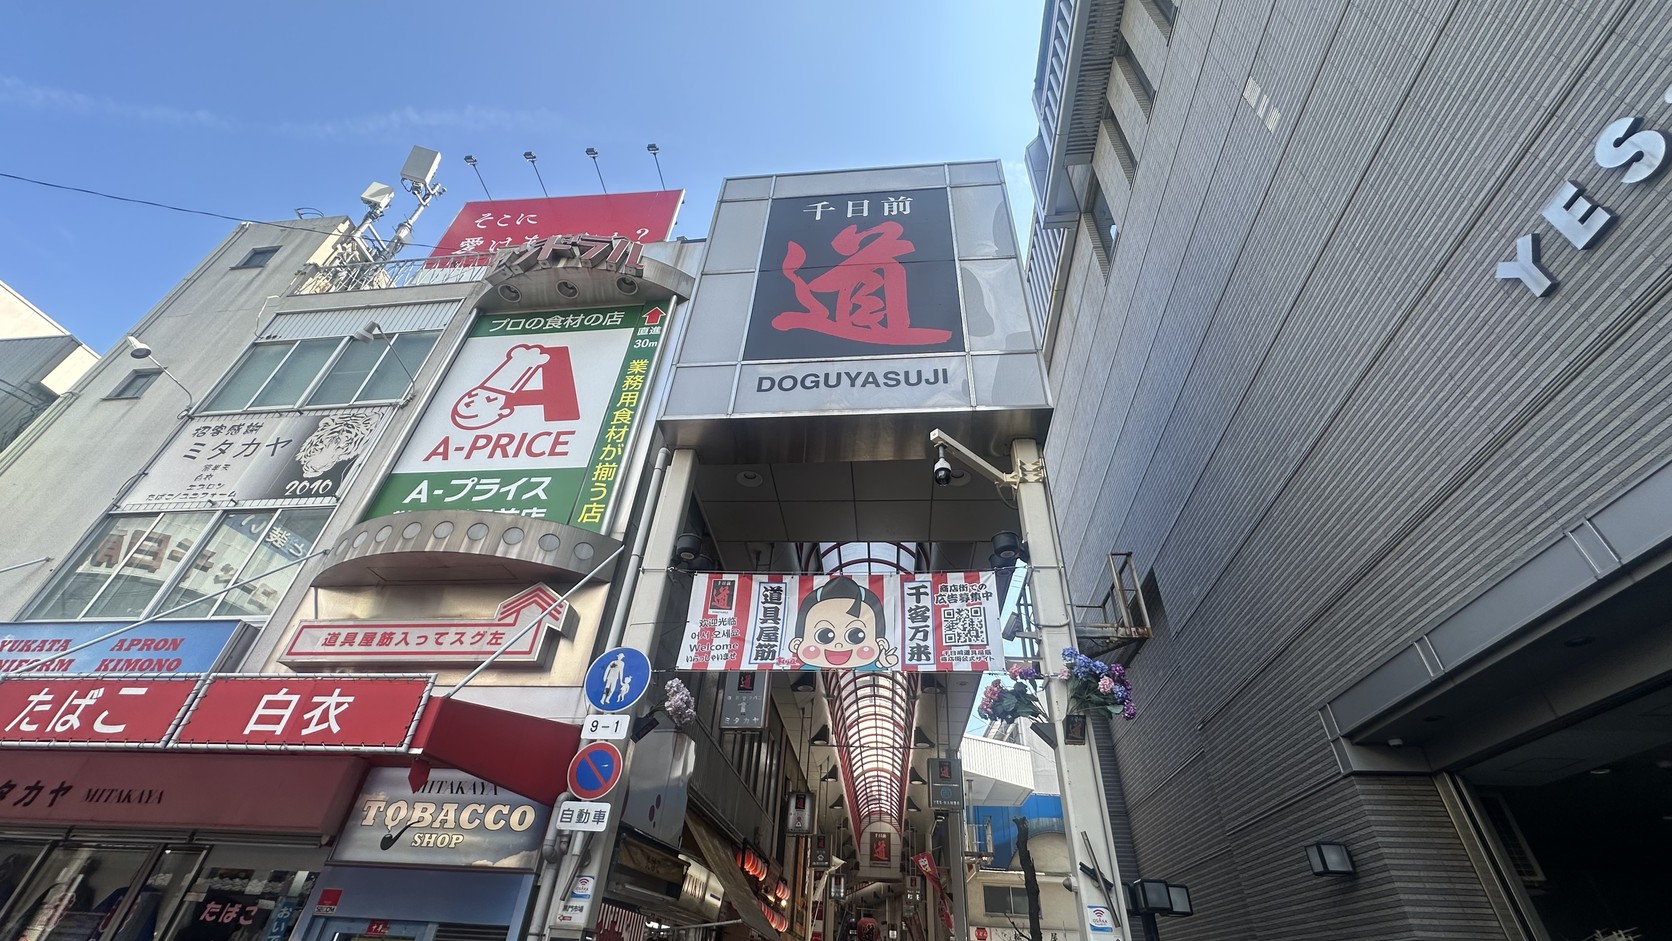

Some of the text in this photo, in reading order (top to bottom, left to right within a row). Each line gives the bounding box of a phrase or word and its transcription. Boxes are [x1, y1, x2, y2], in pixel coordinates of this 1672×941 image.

[803, 196, 913, 220] 千日前
[475, 212, 538, 228] そこに
[771, 221, 952, 345] 道
[489, 311, 625, 332] プロの食材の店
[637, 326, 662, 336] 直進
[633, 339, 658, 349] 30m
[756, 368, 949, 393] DOGUYASUJI
[183, 437, 293, 460] ミタカヤ
[423, 430, 576, 462] A-PRICE
[578, 358, 649, 523] 業務用食材が揃う店
[285, 479, 333, 496] 2010
[402, 477, 552, 503] A-プライス
[940, 583, 987, 592] 商店街での
[935, 591, 993, 604] 広告募集中
[753, 585, 783, 661] 道具屋筋
[906, 584, 931, 662] 千客万来
[0, 638, 184, 653] YUKATA APRON
[321, 631, 506, 647] 道具屋筋入ってスグ左
[689, 642, 739, 652] Welcome
[95, 658, 183, 672] KIMONO
[685, 653, 737, 663] いらっしゃいませ
[5, 687, 148, 733] たばこ
[242, 688, 355, 736] 白衣
[83, 788, 165, 805] MITAKAYA
[361, 800, 536, 832] TOBACCO
[559, 808, 606, 825] 自動車
[411, 833, 464, 848] SHOP
[199, 901, 258, 925] たばこ
